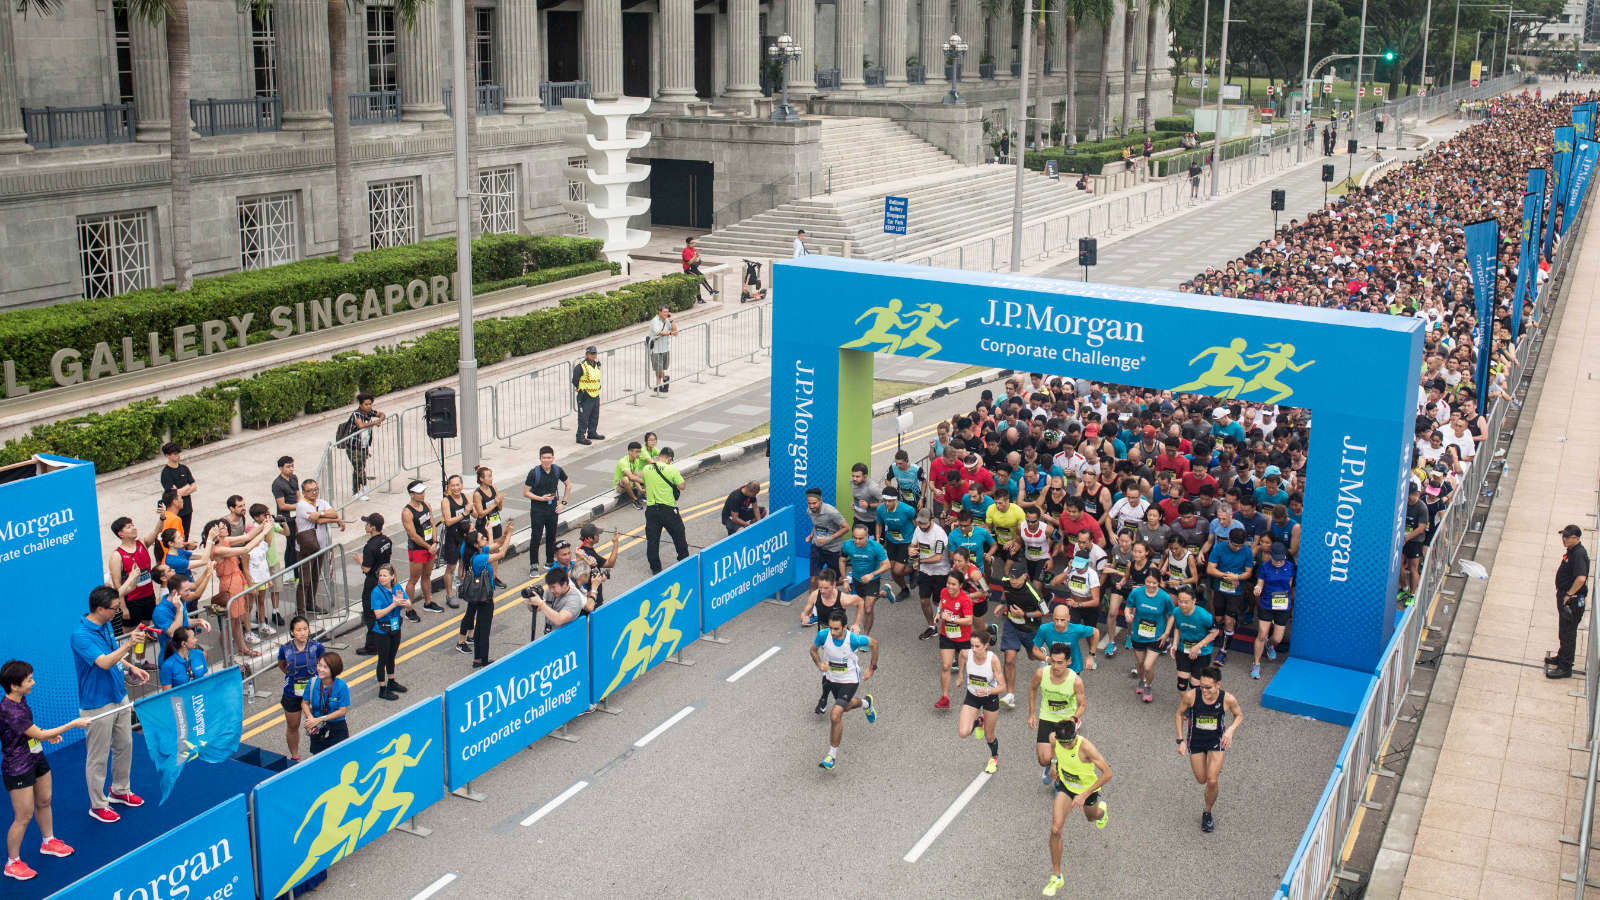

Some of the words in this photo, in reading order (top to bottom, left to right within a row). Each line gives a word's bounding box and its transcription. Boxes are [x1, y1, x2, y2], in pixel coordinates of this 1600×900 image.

[51, 312, 254, 387] GALLERY
[980, 299, 1144, 348] J.P.Morgan
[980, 338, 1057, 359] Corporate
[788, 360, 815, 487] J.P.Morgan
[1325, 435, 1368, 583] J.P.Morgan
[709, 530, 789, 587] J.P.Morgan
[711, 580, 751, 609] Corporate
[460, 650, 578, 733] J.P.Morgan
[462, 718, 521, 761] Corporate
